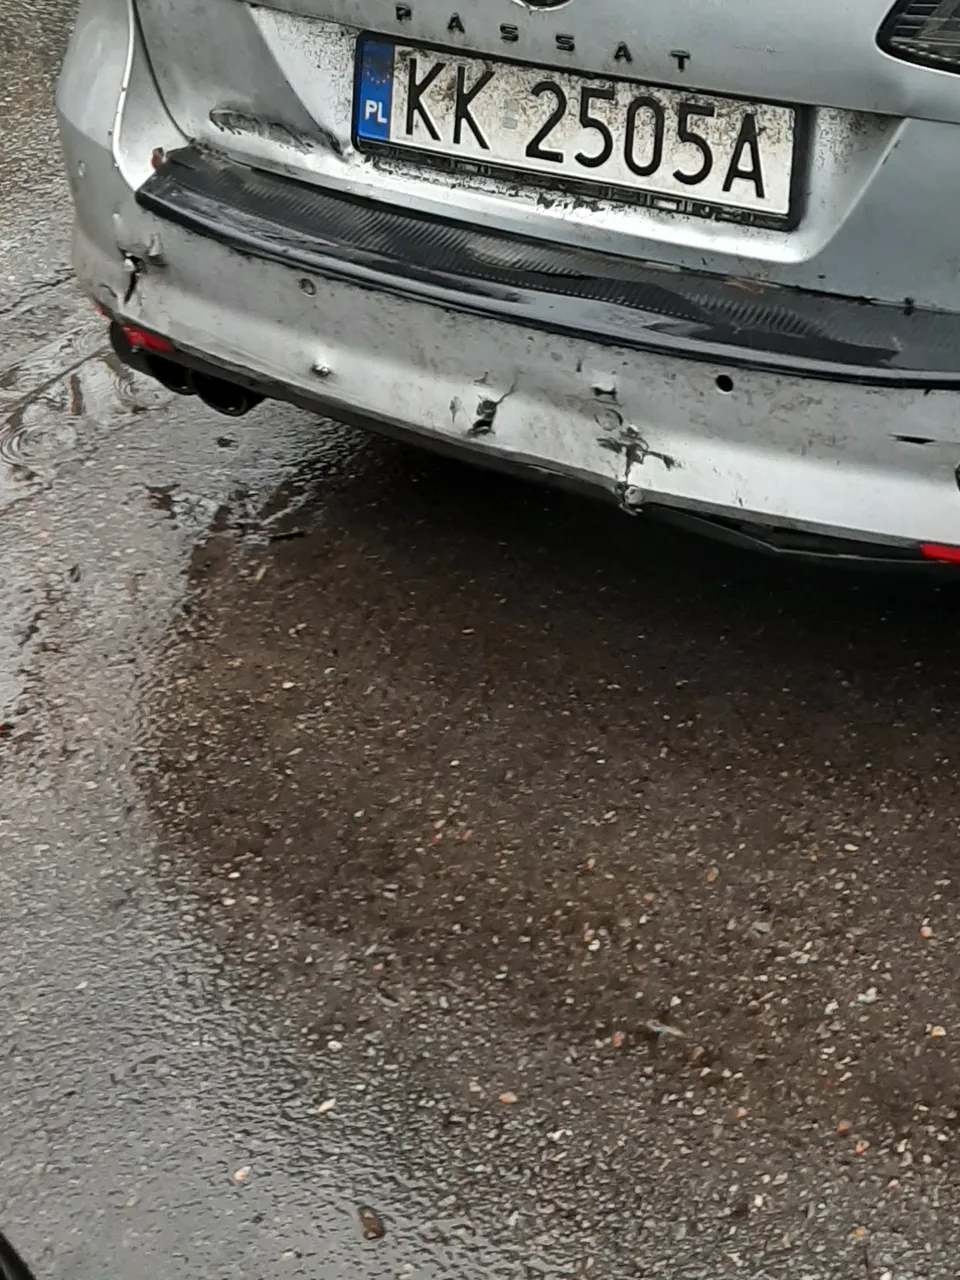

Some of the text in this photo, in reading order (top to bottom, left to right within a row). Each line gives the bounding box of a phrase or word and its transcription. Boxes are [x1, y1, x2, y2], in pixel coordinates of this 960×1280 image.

[394, 3, 692, 73] PASSAT
[364, 99, 388, 125] PL
[405, 57, 766, 199] KK 2505A
